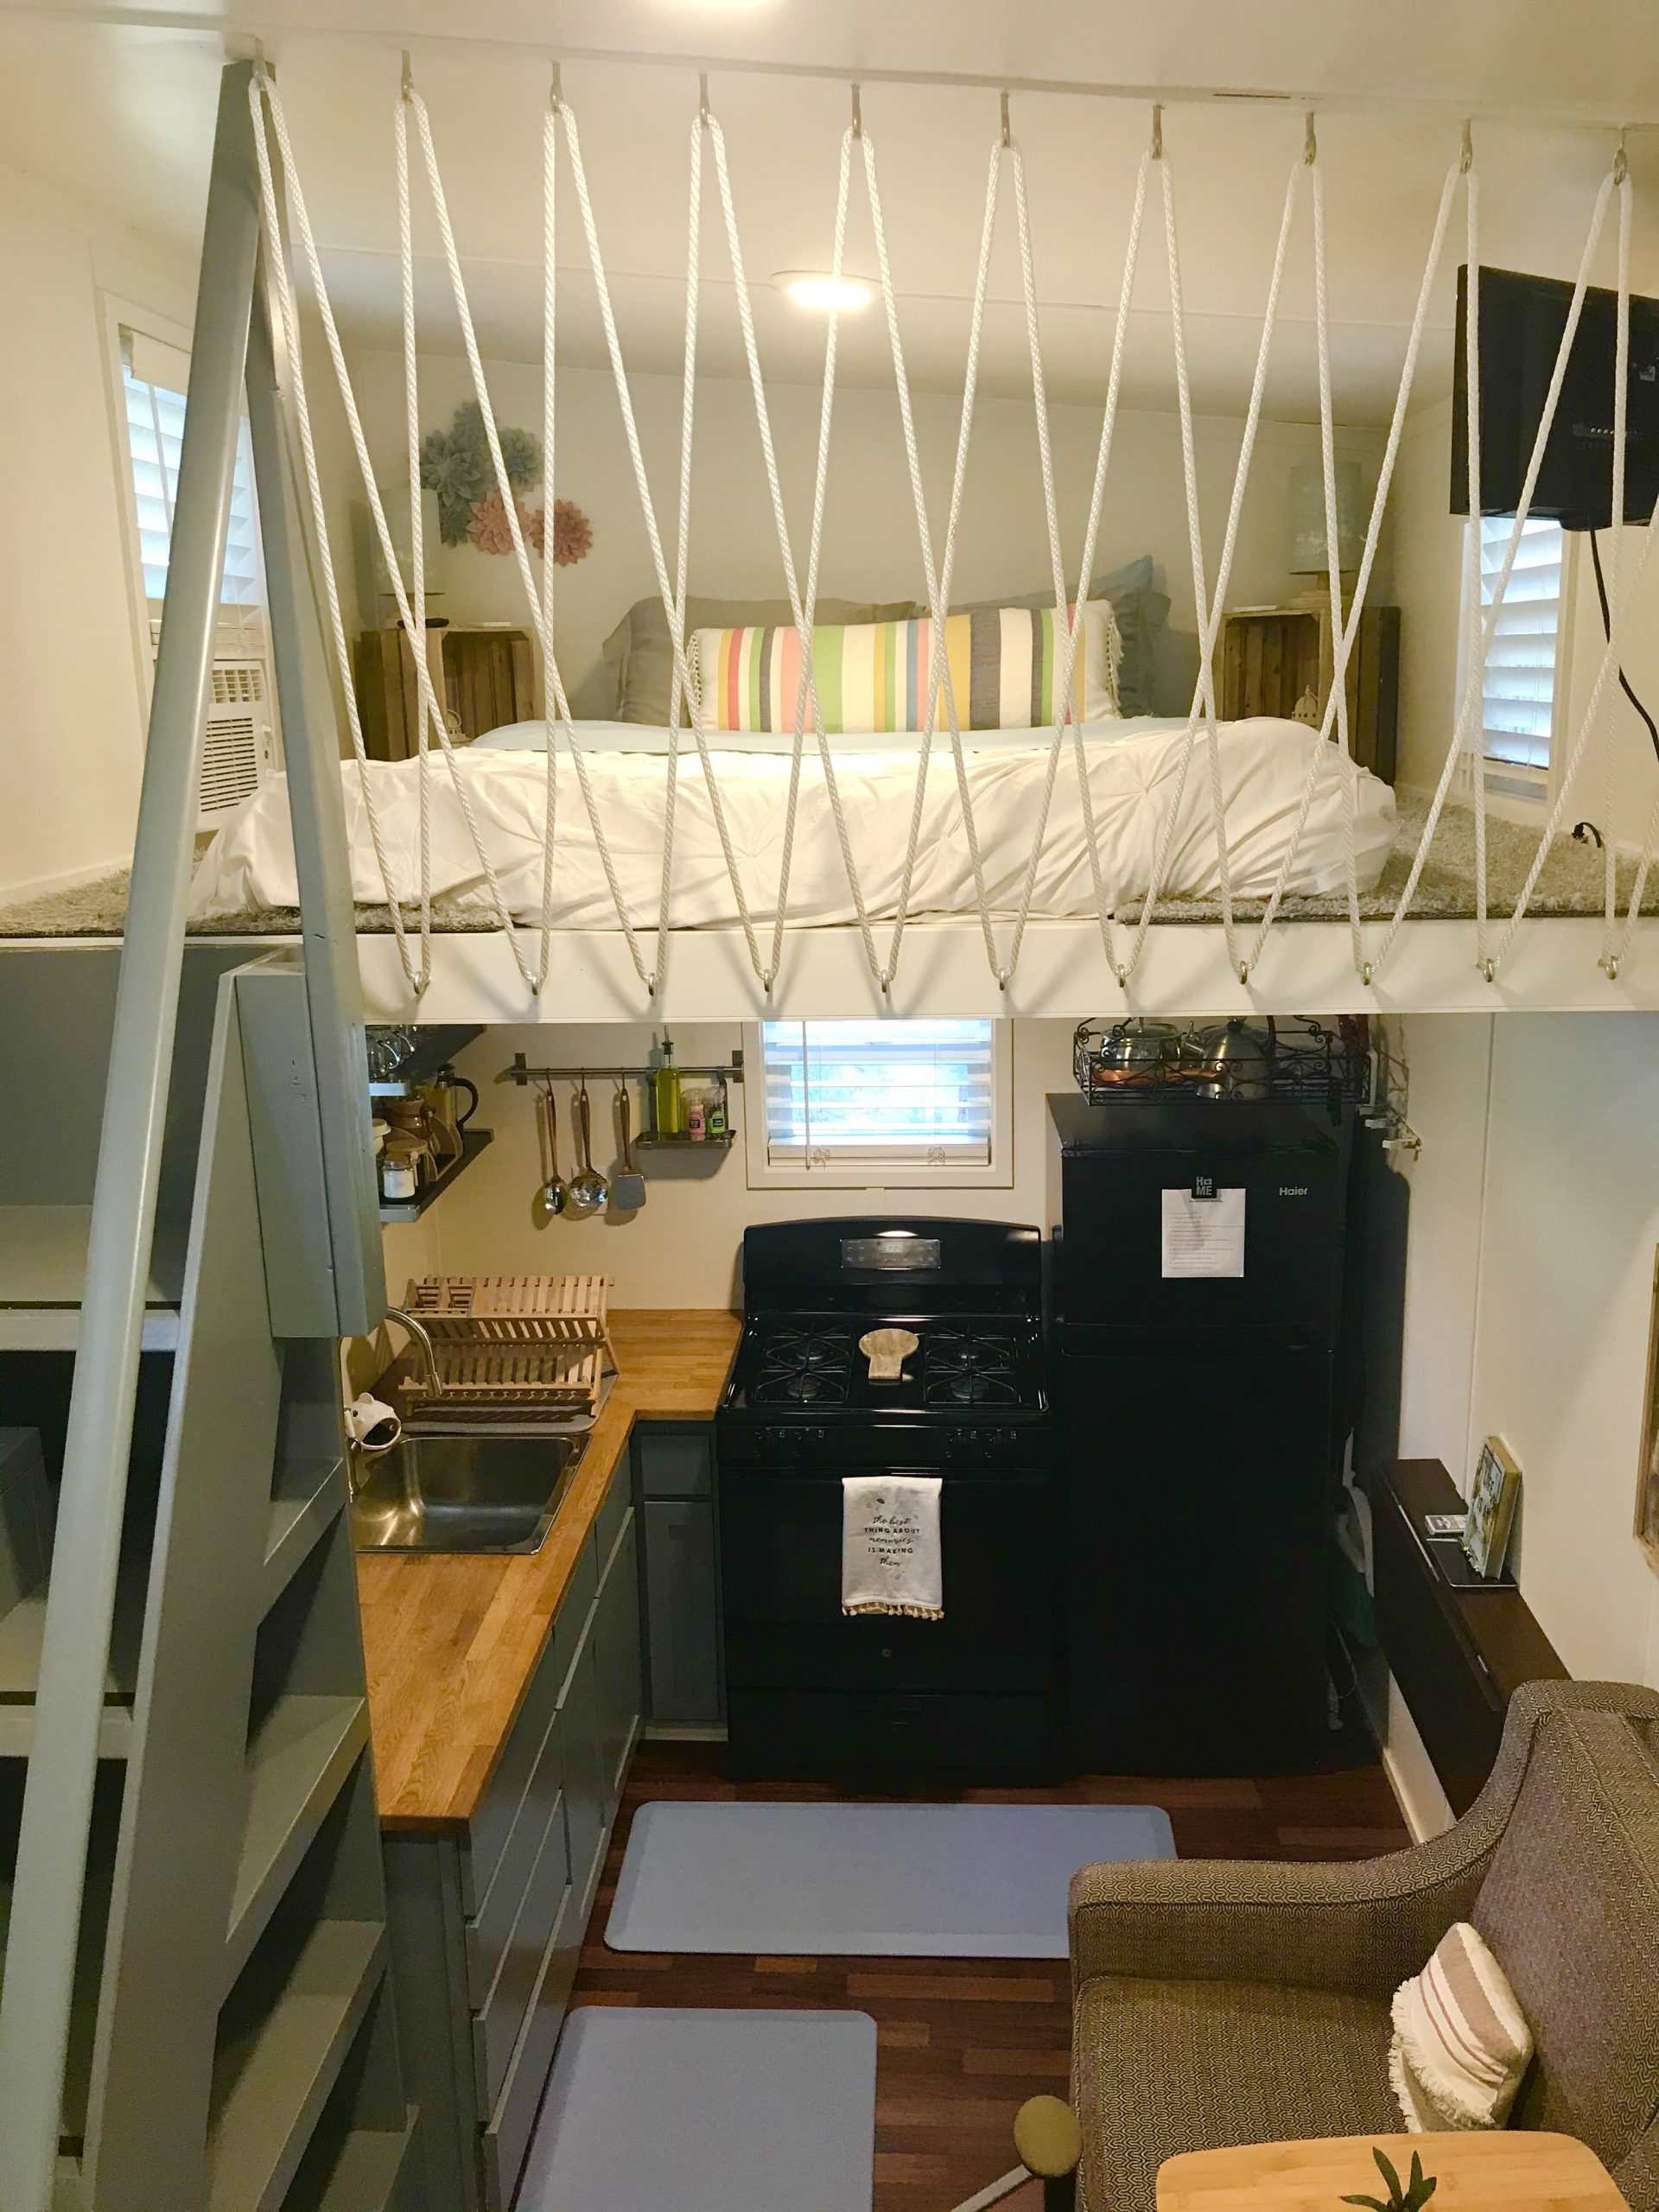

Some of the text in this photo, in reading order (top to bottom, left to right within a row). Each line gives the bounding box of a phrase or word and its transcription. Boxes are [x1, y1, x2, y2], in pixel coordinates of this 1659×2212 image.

[1279, 1186, 1308, 1196] Haier
[873, 1515, 911, 1525] the best
[880, 1556, 901, 1567] them
